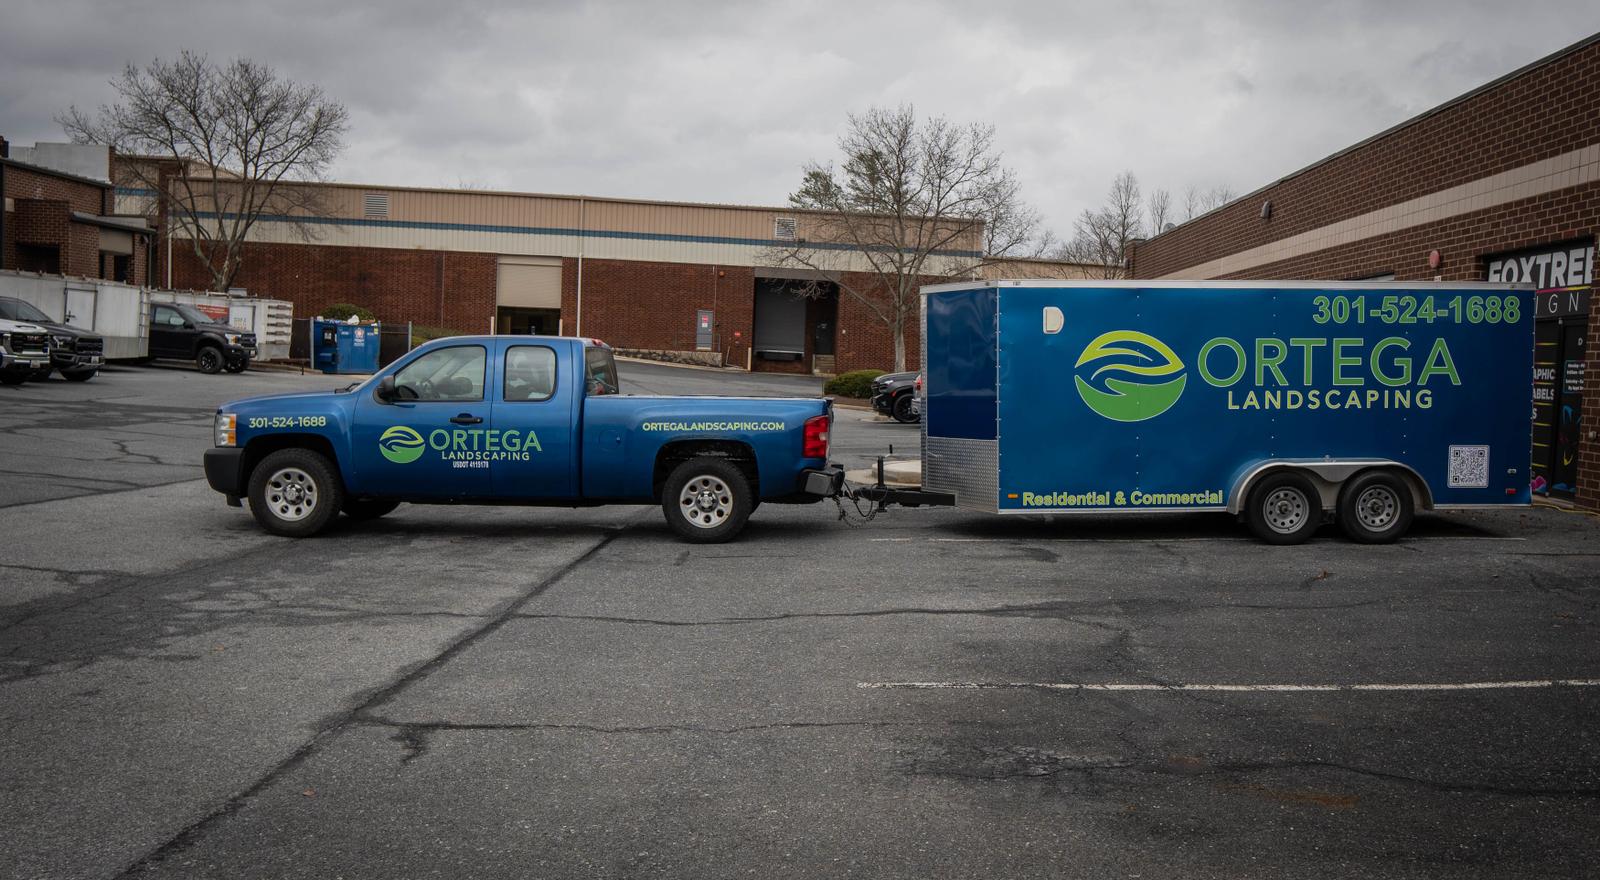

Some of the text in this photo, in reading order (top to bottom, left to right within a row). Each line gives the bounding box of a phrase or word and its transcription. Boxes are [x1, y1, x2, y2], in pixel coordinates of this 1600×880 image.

[1312, 295, 1521, 324] 301-524-1688
[1535, 292, 1580, 314] IGN
[1197, 336, 1462, 387] ORTEGA
[1533, 368, 1556, 380] APHIC
[1227, 389, 1434, 410] LANDSCAPING
[1533, 388, 1555, 400] ABELS
[249, 416, 327, 429] 301-524-1688
[642, 421, 785, 431] ORTEGALANDSCAPING.COM
[429, 428, 543, 452] ORTEGA
[441, 451, 530, 461] LANDSCAPING
[452, 460, 469, 468] USDOT
[1022, 489, 1223, 506] Residential & Commercial
